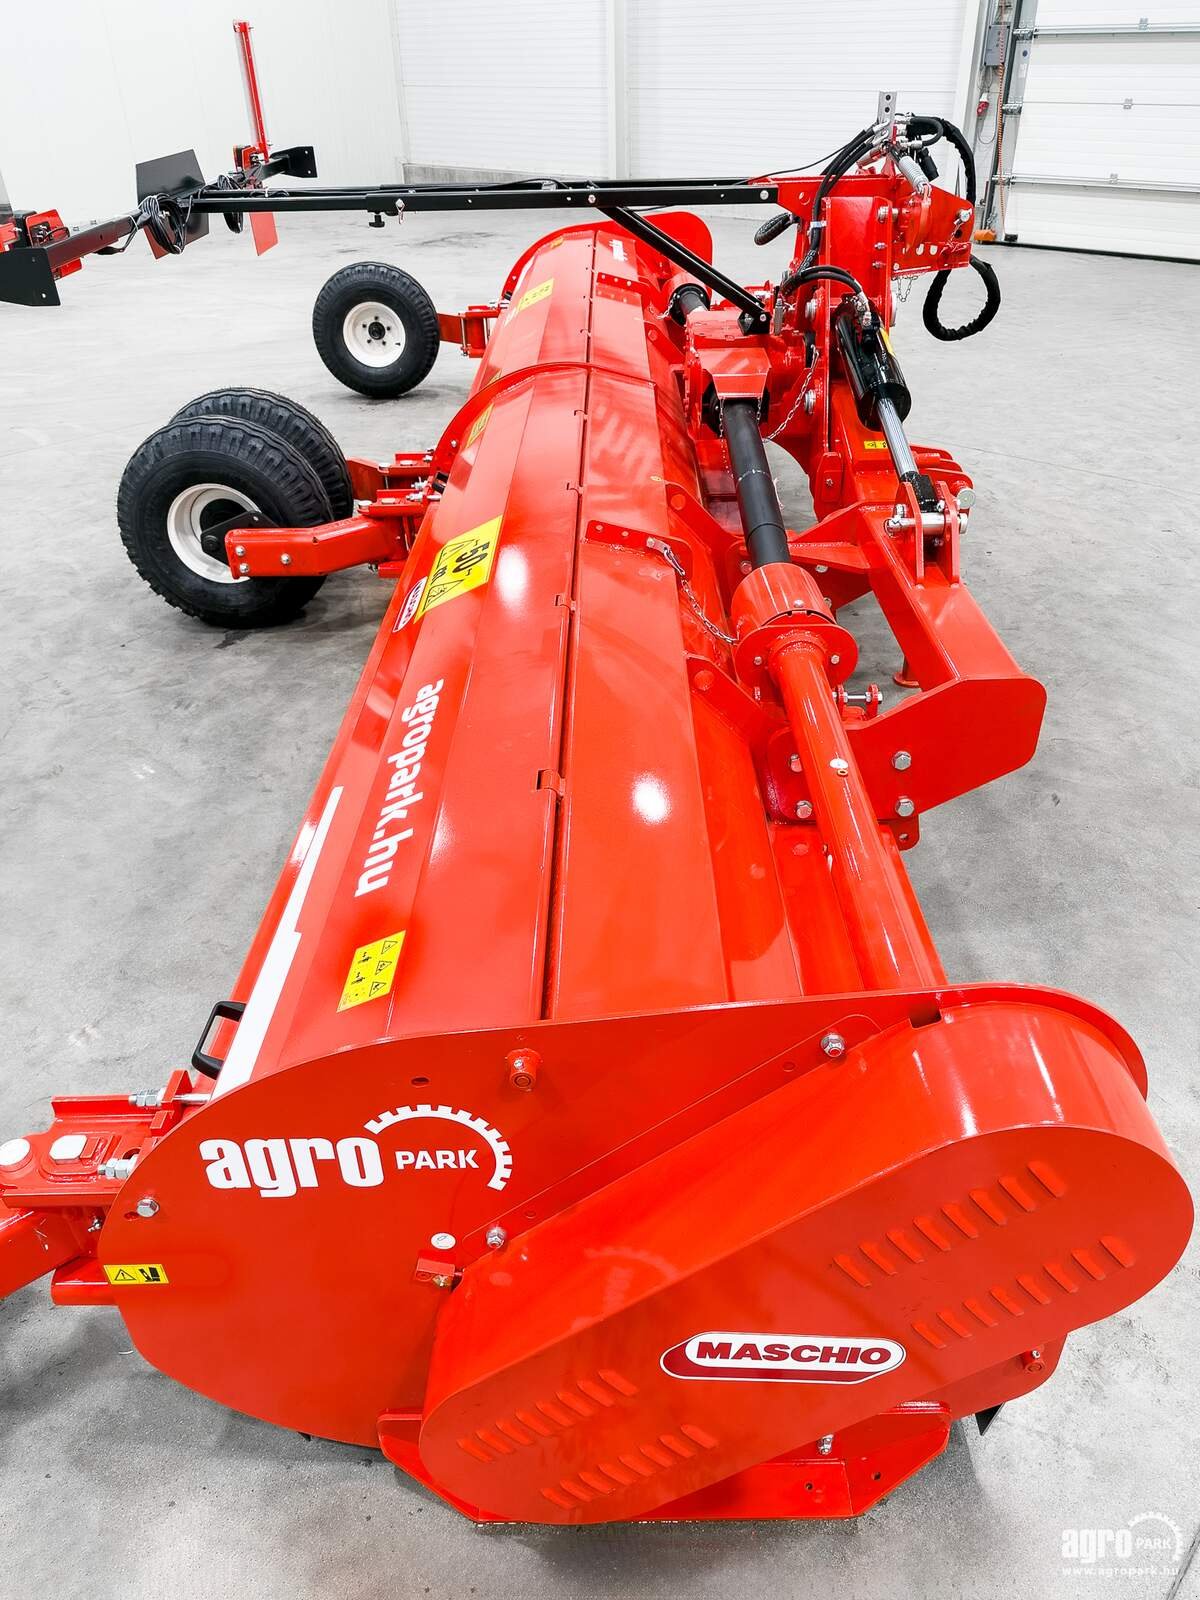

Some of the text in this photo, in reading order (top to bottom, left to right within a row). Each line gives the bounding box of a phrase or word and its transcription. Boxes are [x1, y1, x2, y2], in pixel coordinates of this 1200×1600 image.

[452, 540, 490, 573] 50
[354, 679, 444, 898] agropark.hu
[199, 1137, 479, 1198] agro PARK
[696, 1341, 892, 1365] MASCHIO
